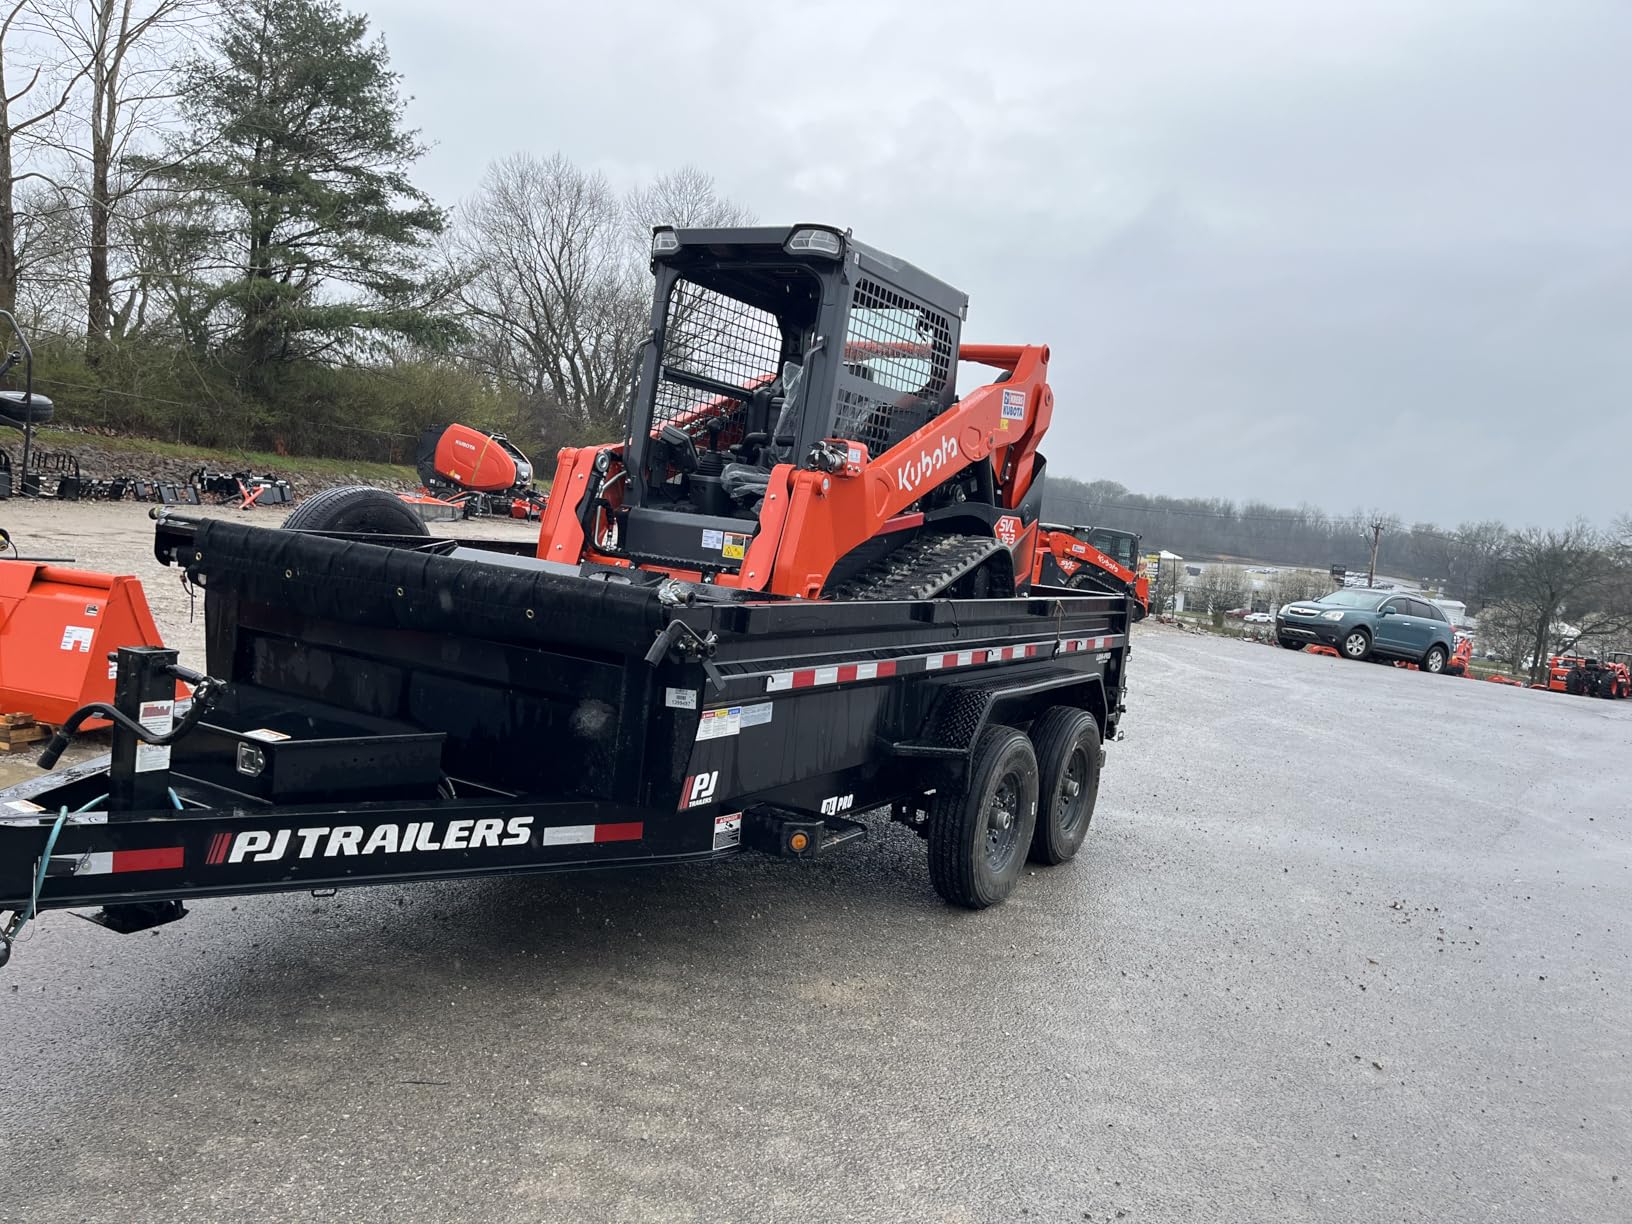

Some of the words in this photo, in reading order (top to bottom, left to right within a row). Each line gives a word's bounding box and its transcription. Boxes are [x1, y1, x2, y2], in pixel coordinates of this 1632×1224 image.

[1003, 405, 1023, 417] KUBOTA
[898, 435, 957, 491] Kubota
[999, 519, 1015, 532] SVL
[1097, 555, 1118, 573] Kubota
[690, 771, 718, 800] PJ
[689, 797, 712, 807] TRAILERS
[837, 794, 853, 811] PRO
[227, 829, 292, 864] PJ
[297, 816, 535, 859] TRAILERS
